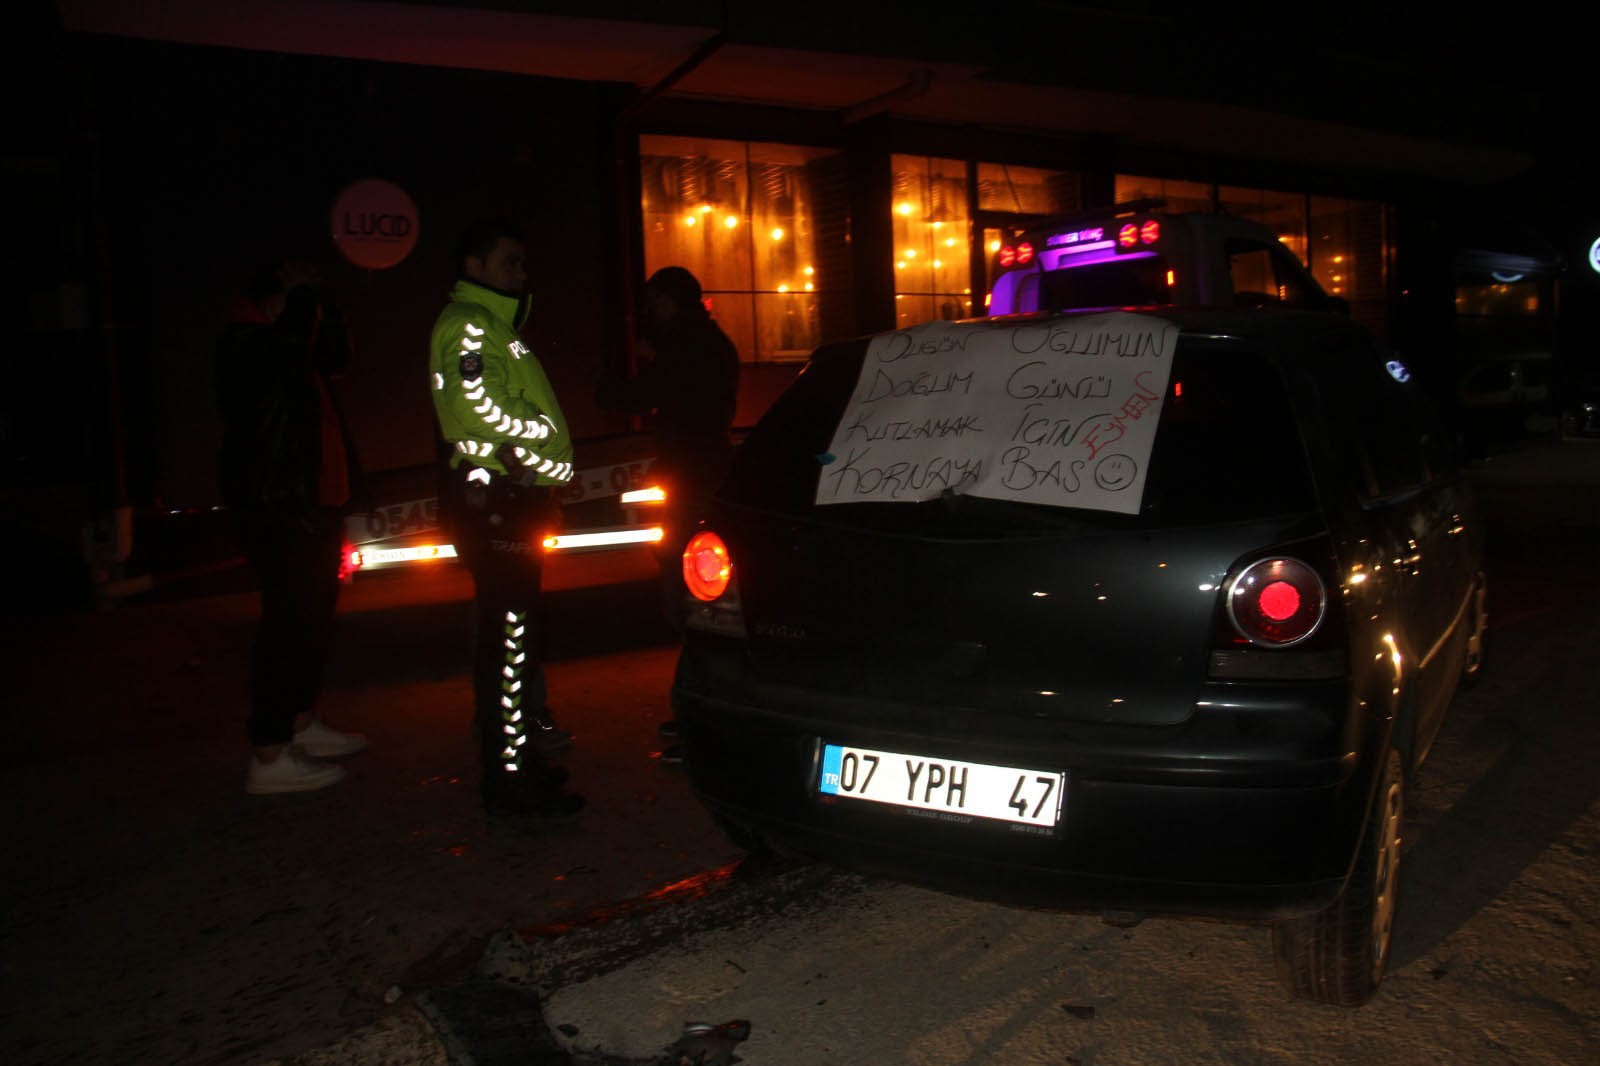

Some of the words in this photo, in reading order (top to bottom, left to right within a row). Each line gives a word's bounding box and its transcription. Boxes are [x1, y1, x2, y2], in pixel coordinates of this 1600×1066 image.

[344, 212, 410, 236] LUCID
[1006, 361, 1113, 400] GÜNÜ
[1002, 446, 1086, 493] BAS
[824, 772, 839, 786] TR
[841, 752, 880, 794] 07
[905, 759, 969, 808] YPH
[1008, 775, 1056, 819] 47
